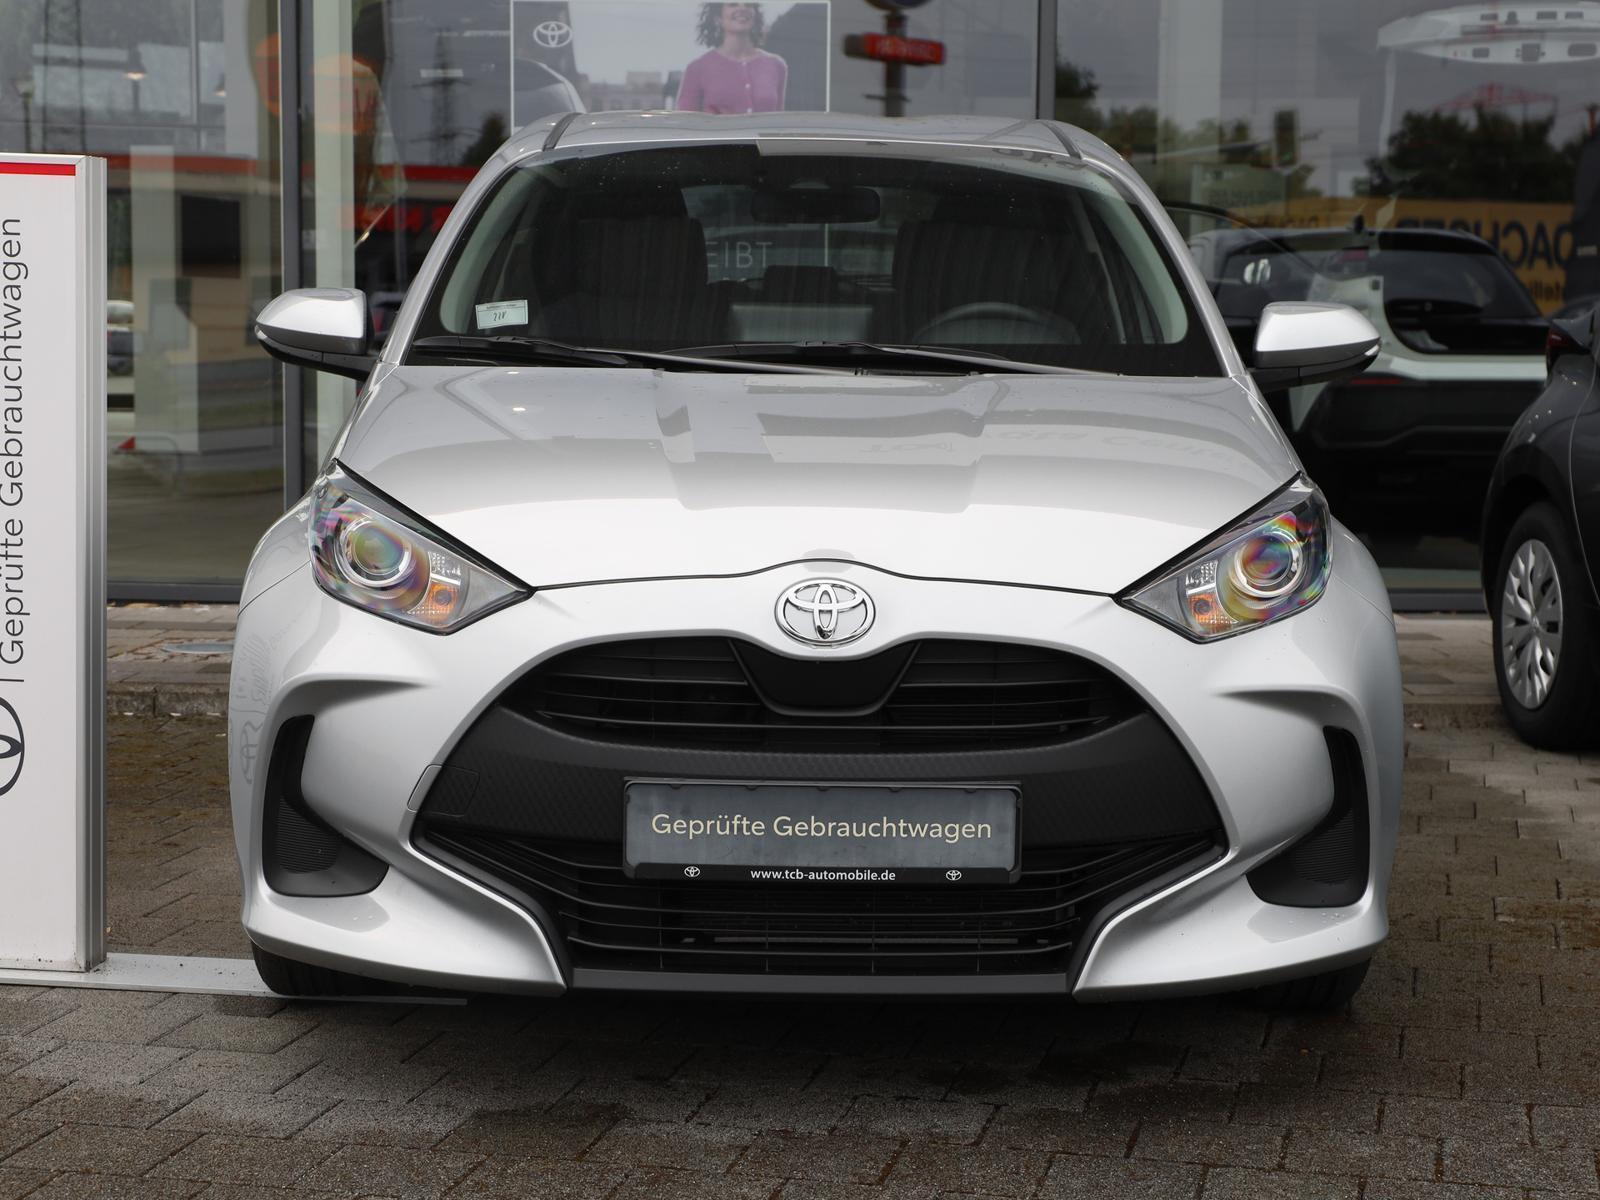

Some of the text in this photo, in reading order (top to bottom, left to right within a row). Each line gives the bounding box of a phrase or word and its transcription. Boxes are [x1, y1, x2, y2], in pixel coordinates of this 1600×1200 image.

[0, 218, 31, 665] Geprüfte Gebrauchtwagen
[651, 813, 992, 844] Geprüfte Gebrauchtwagen
[750, 868, 896, 882] www.tcb-automobile.de
